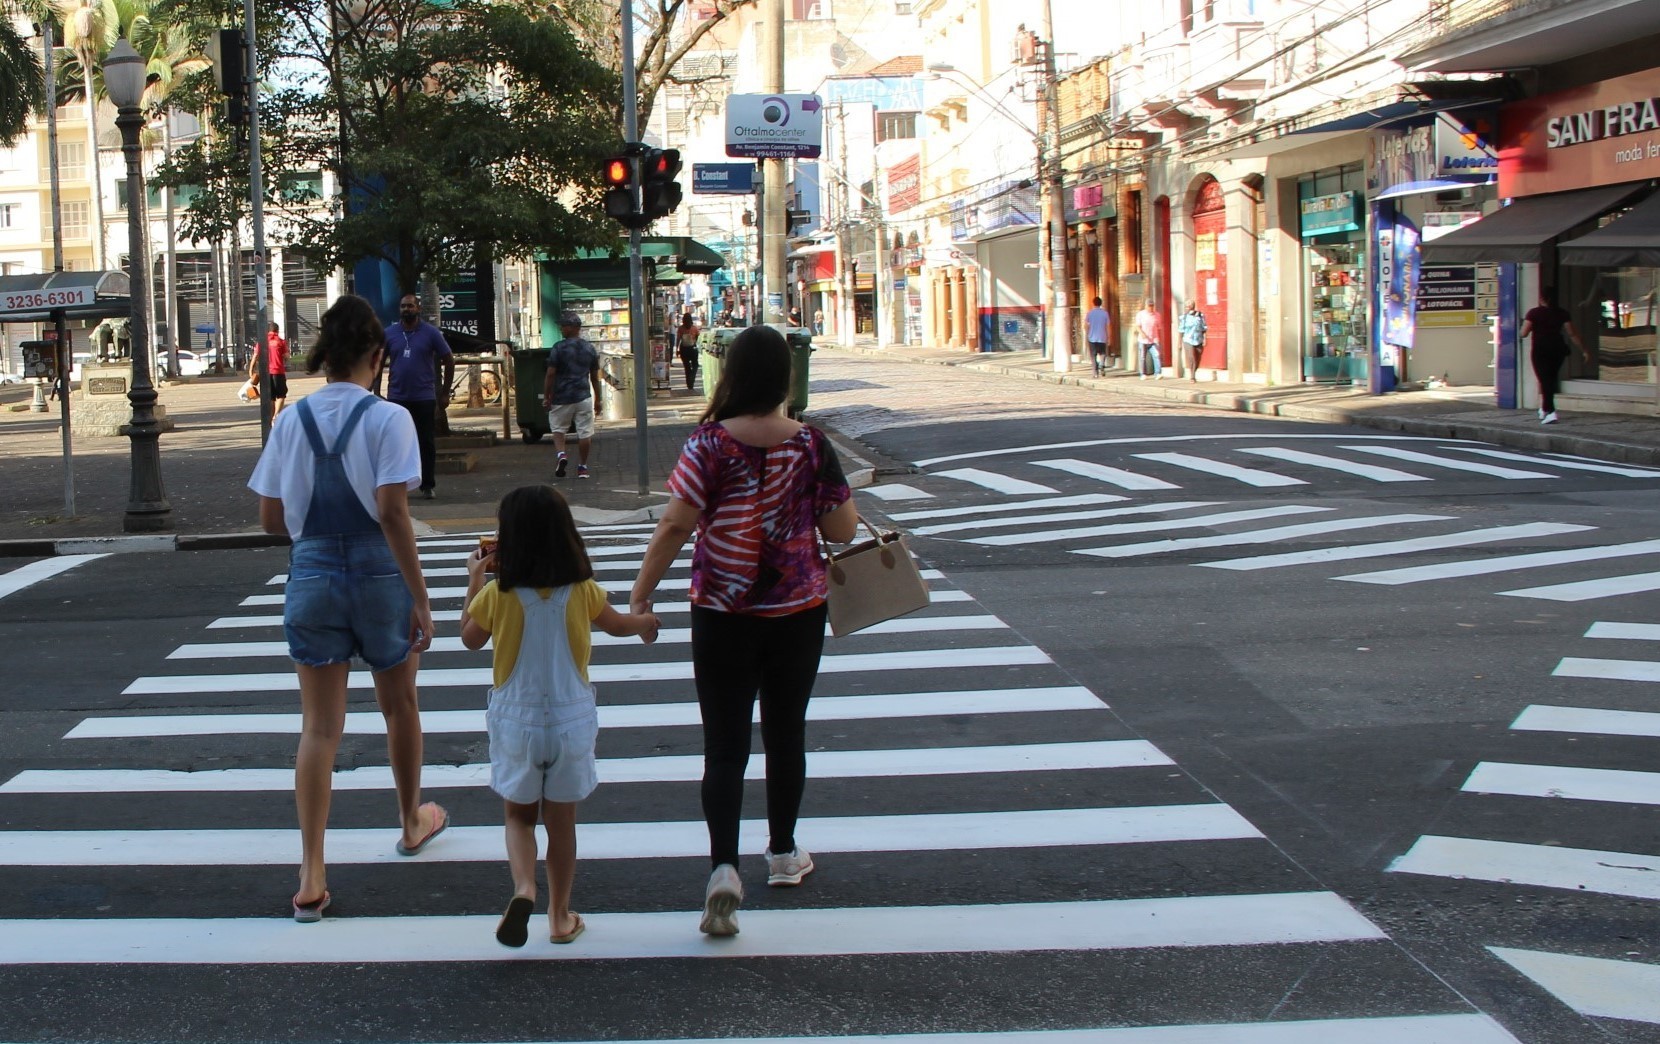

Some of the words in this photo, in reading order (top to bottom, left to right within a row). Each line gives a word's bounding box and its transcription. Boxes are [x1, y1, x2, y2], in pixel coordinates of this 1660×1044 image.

[734, 126, 806, 137] Oftalmocenter
[1547, 110, 1594, 149] SAN
[1603, 98, 1660, 138] FRA
[1616, 143, 1642, 163] moda
[701, 170, 729, 181] Constant
[6, 290, 84, 309] 3236-6301
